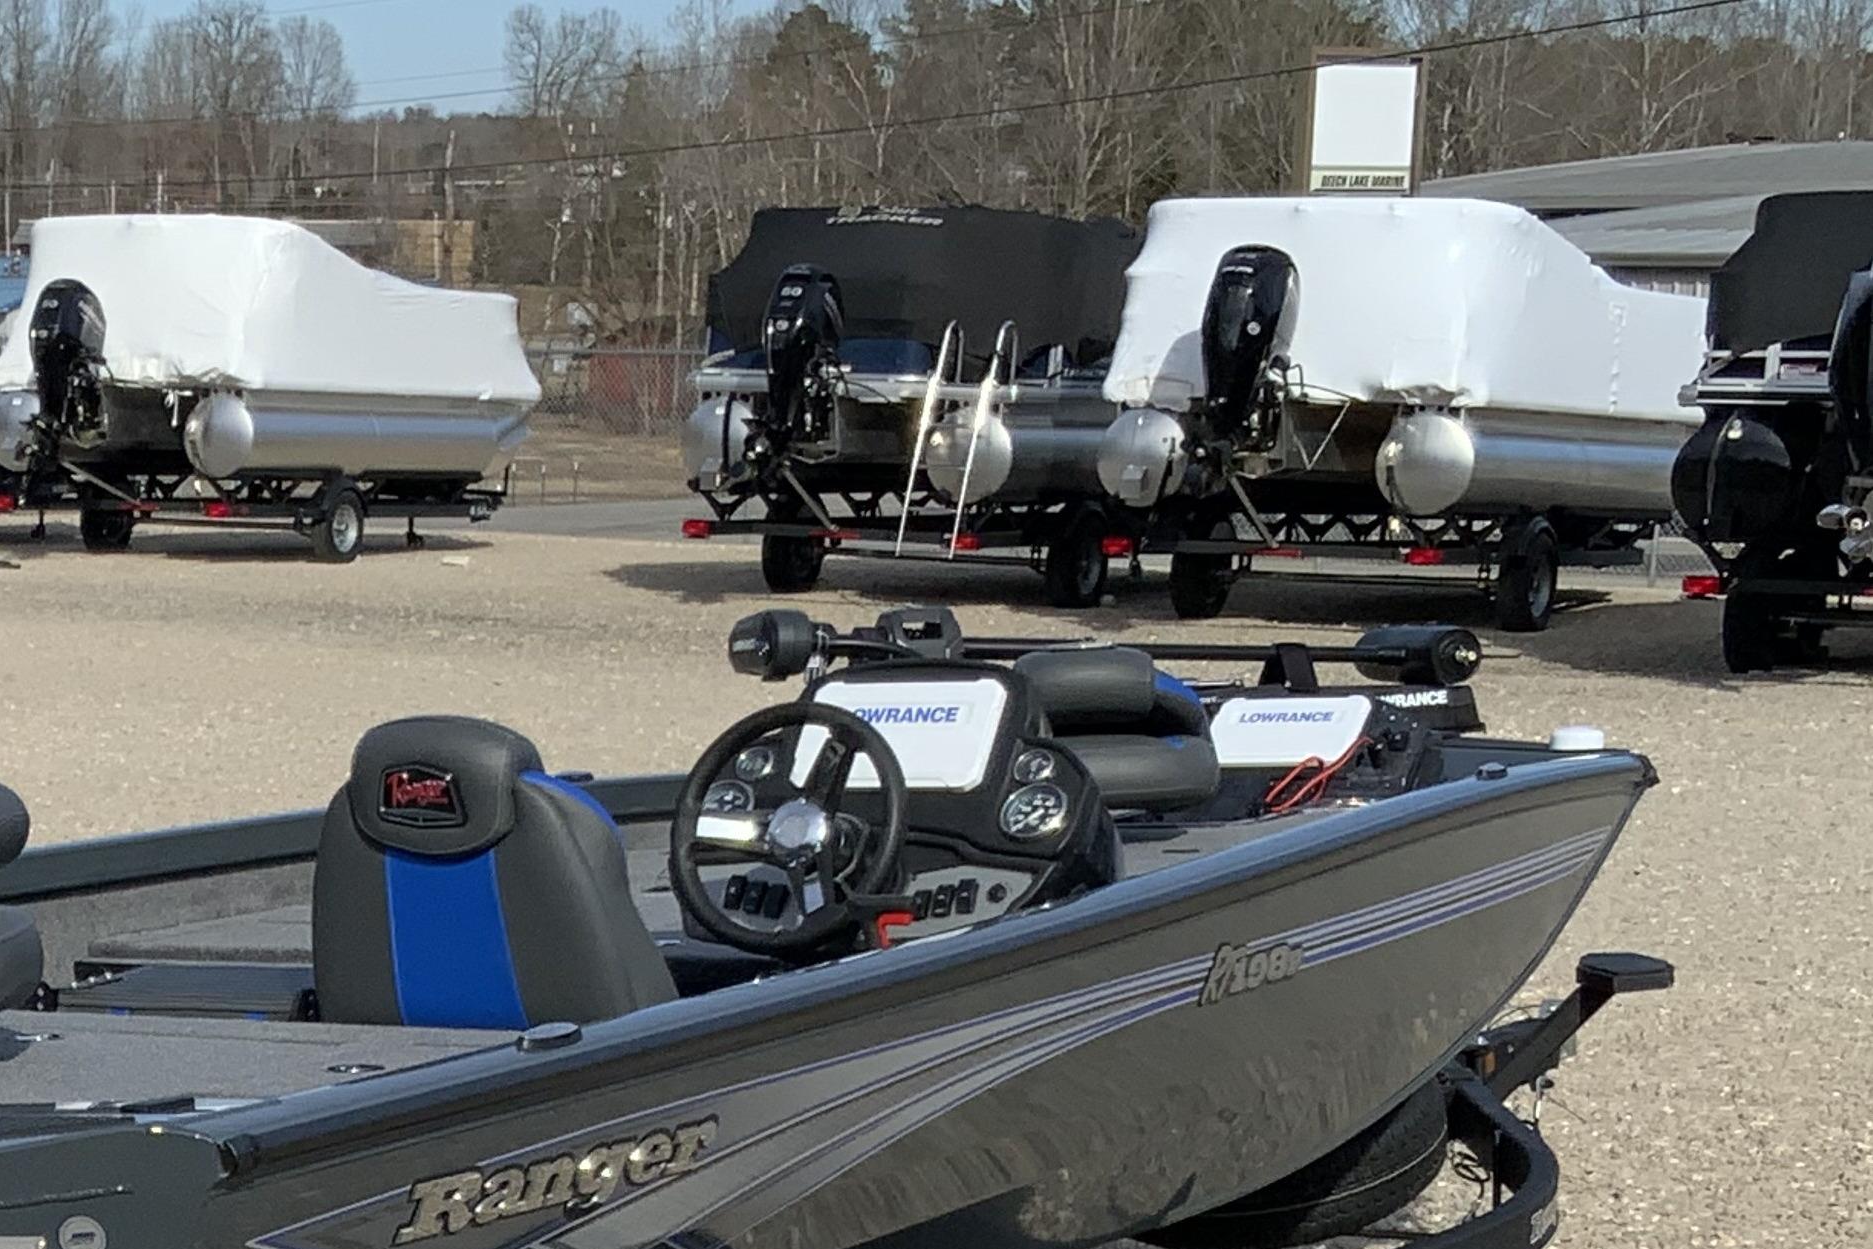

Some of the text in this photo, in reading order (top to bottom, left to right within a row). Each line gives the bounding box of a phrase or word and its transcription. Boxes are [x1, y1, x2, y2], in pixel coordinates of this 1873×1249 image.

[1348, 175, 1370, 188] LAKE
[1375, 689, 1449, 708] WRANCE
[852, 705, 961, 724] OWRANCE
[1238, 711, 1335, 724] LOWRANCE
[390, 1112, 721, 1247] Ranger
